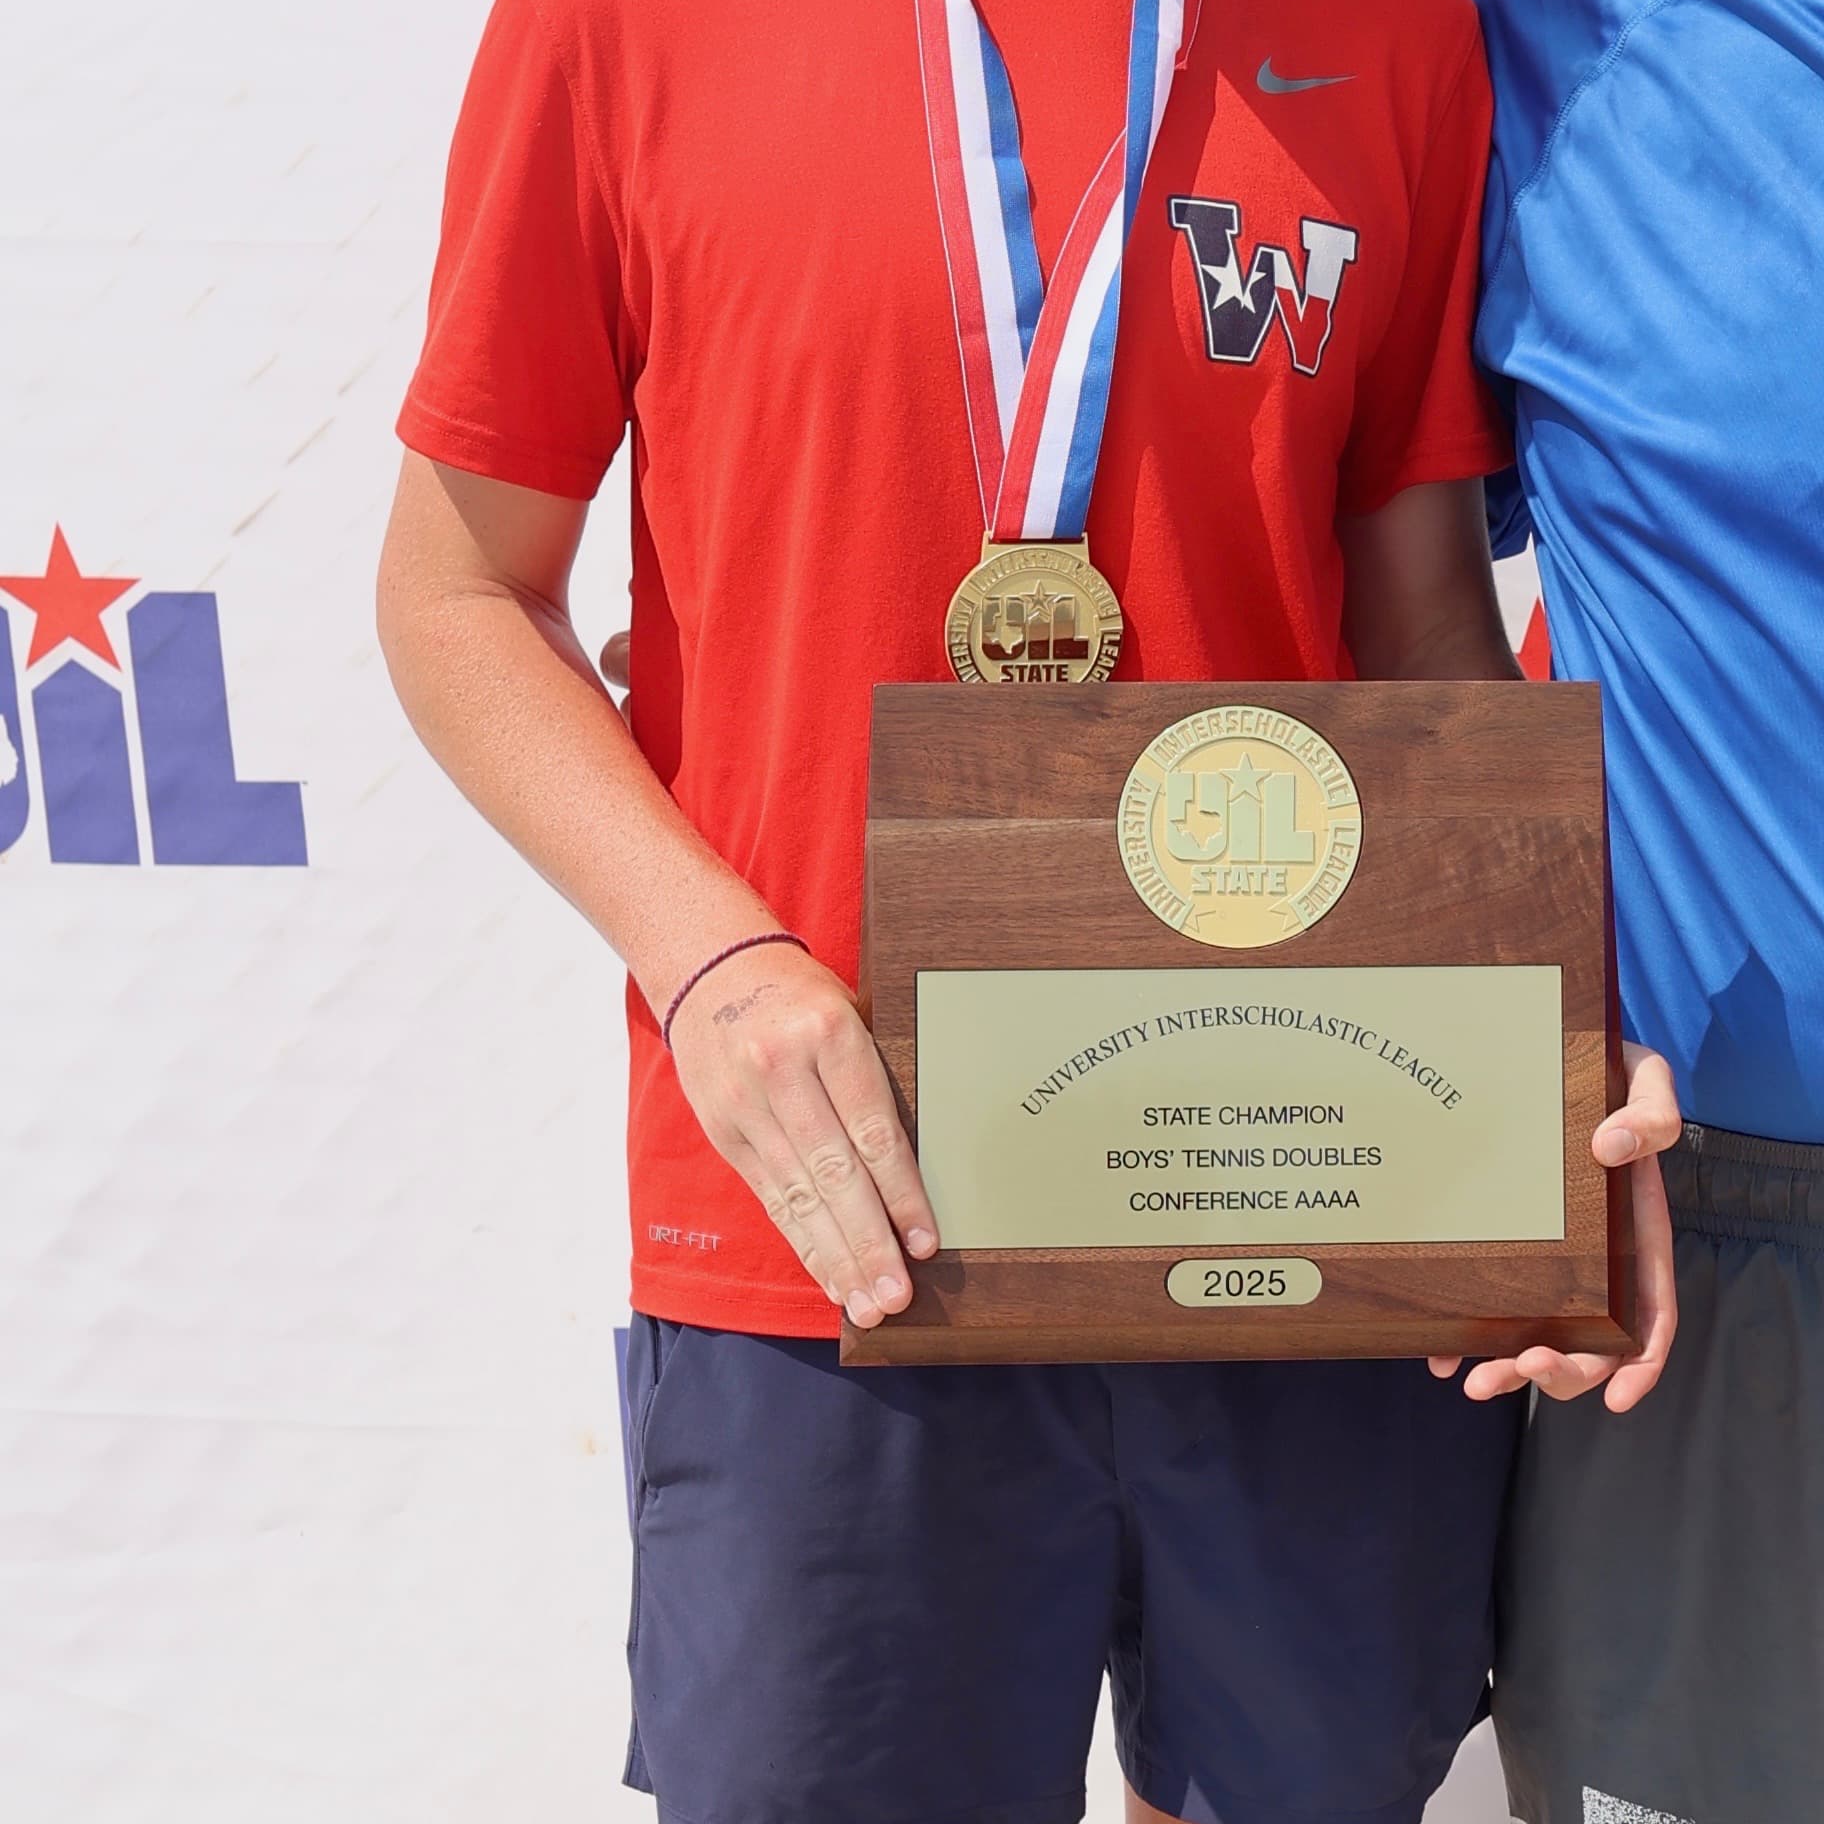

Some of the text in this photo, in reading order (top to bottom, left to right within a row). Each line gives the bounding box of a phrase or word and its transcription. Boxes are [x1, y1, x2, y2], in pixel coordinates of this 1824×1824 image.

[1169, 195, 1359, 378] W
[981, 594, 1089, 661] UIL
[1001, 664, 1069, 683] STATE
[1091, 633, 1121, 682] LEAG
[0, 591, 309, 867] IL
[1123, 709, 1358, 922] UNIVERSITY INTERSCHOLASTIC LEAGUE
[1166, 771, 1316, 864] UIL
[1191, 866, 1289, 896] STATE
[1020, 1005, 1462, 1116] UNIVERSITY INTERSCHOLASTIC LEAGUE
[1143, 1105, 1344, 1127] STATE CHAMPION
[1181, 1148, 1265, 1169] TENNIS
[1272, 1146, 1382, 1167] DOUBLES
[1129, 1189, 1361, 1212] CONFERENCE AAAA
[1203, 1269, 1287, 1297] 2025
